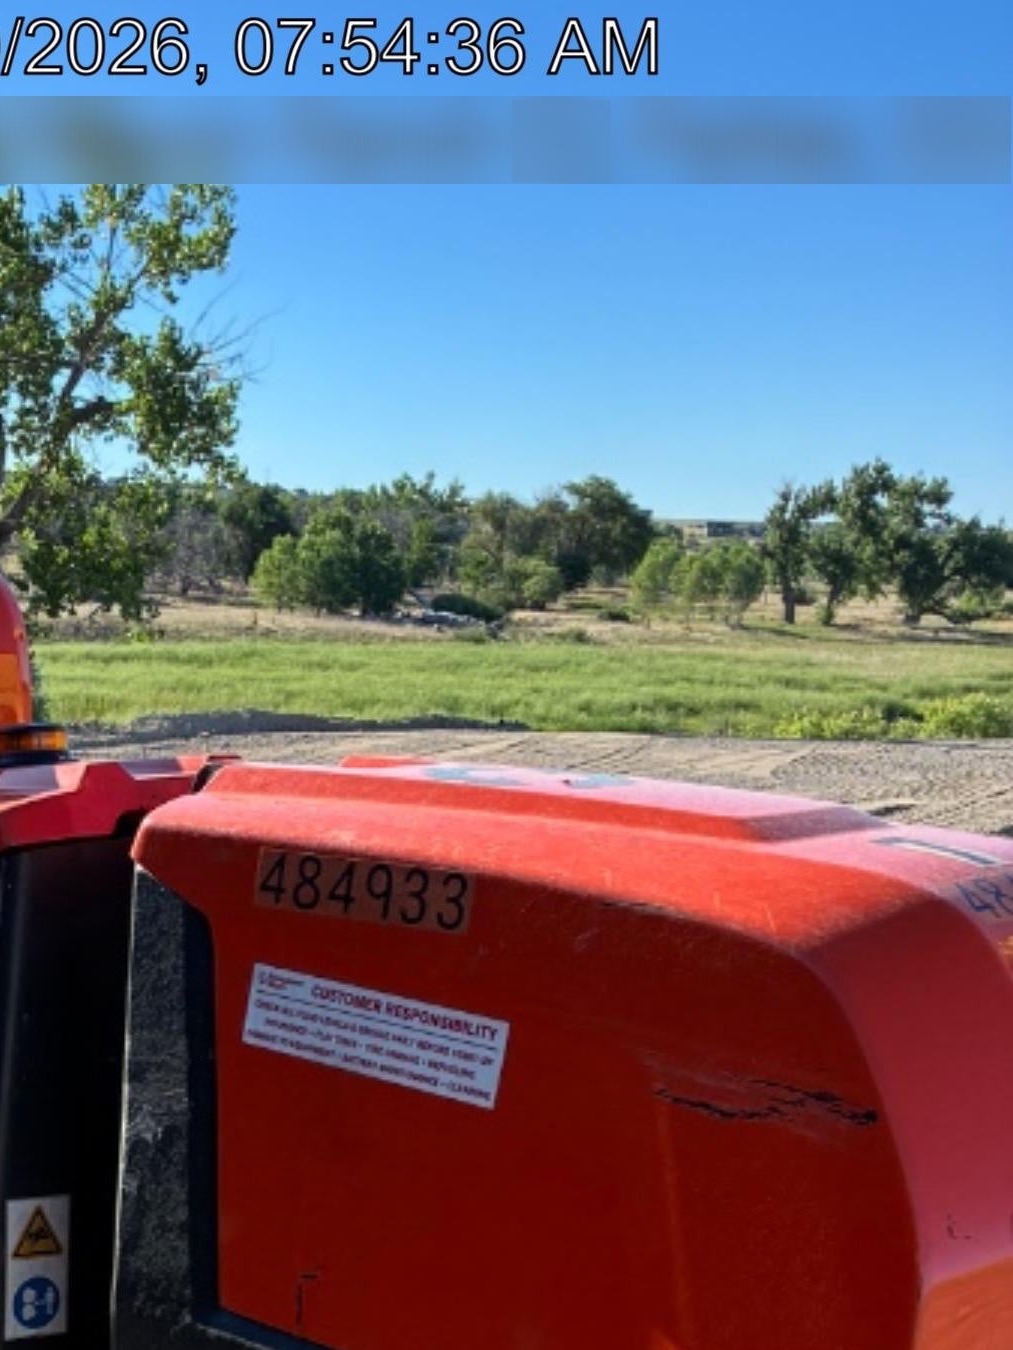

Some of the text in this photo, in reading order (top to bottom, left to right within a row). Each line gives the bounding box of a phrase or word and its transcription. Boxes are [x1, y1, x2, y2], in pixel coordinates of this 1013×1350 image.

[259, 854, 469, 931] 484933
[310, 984, 382, 1014] CUSTOMER
[385, 1000, 499, 1042] RESPONSIBILITY
